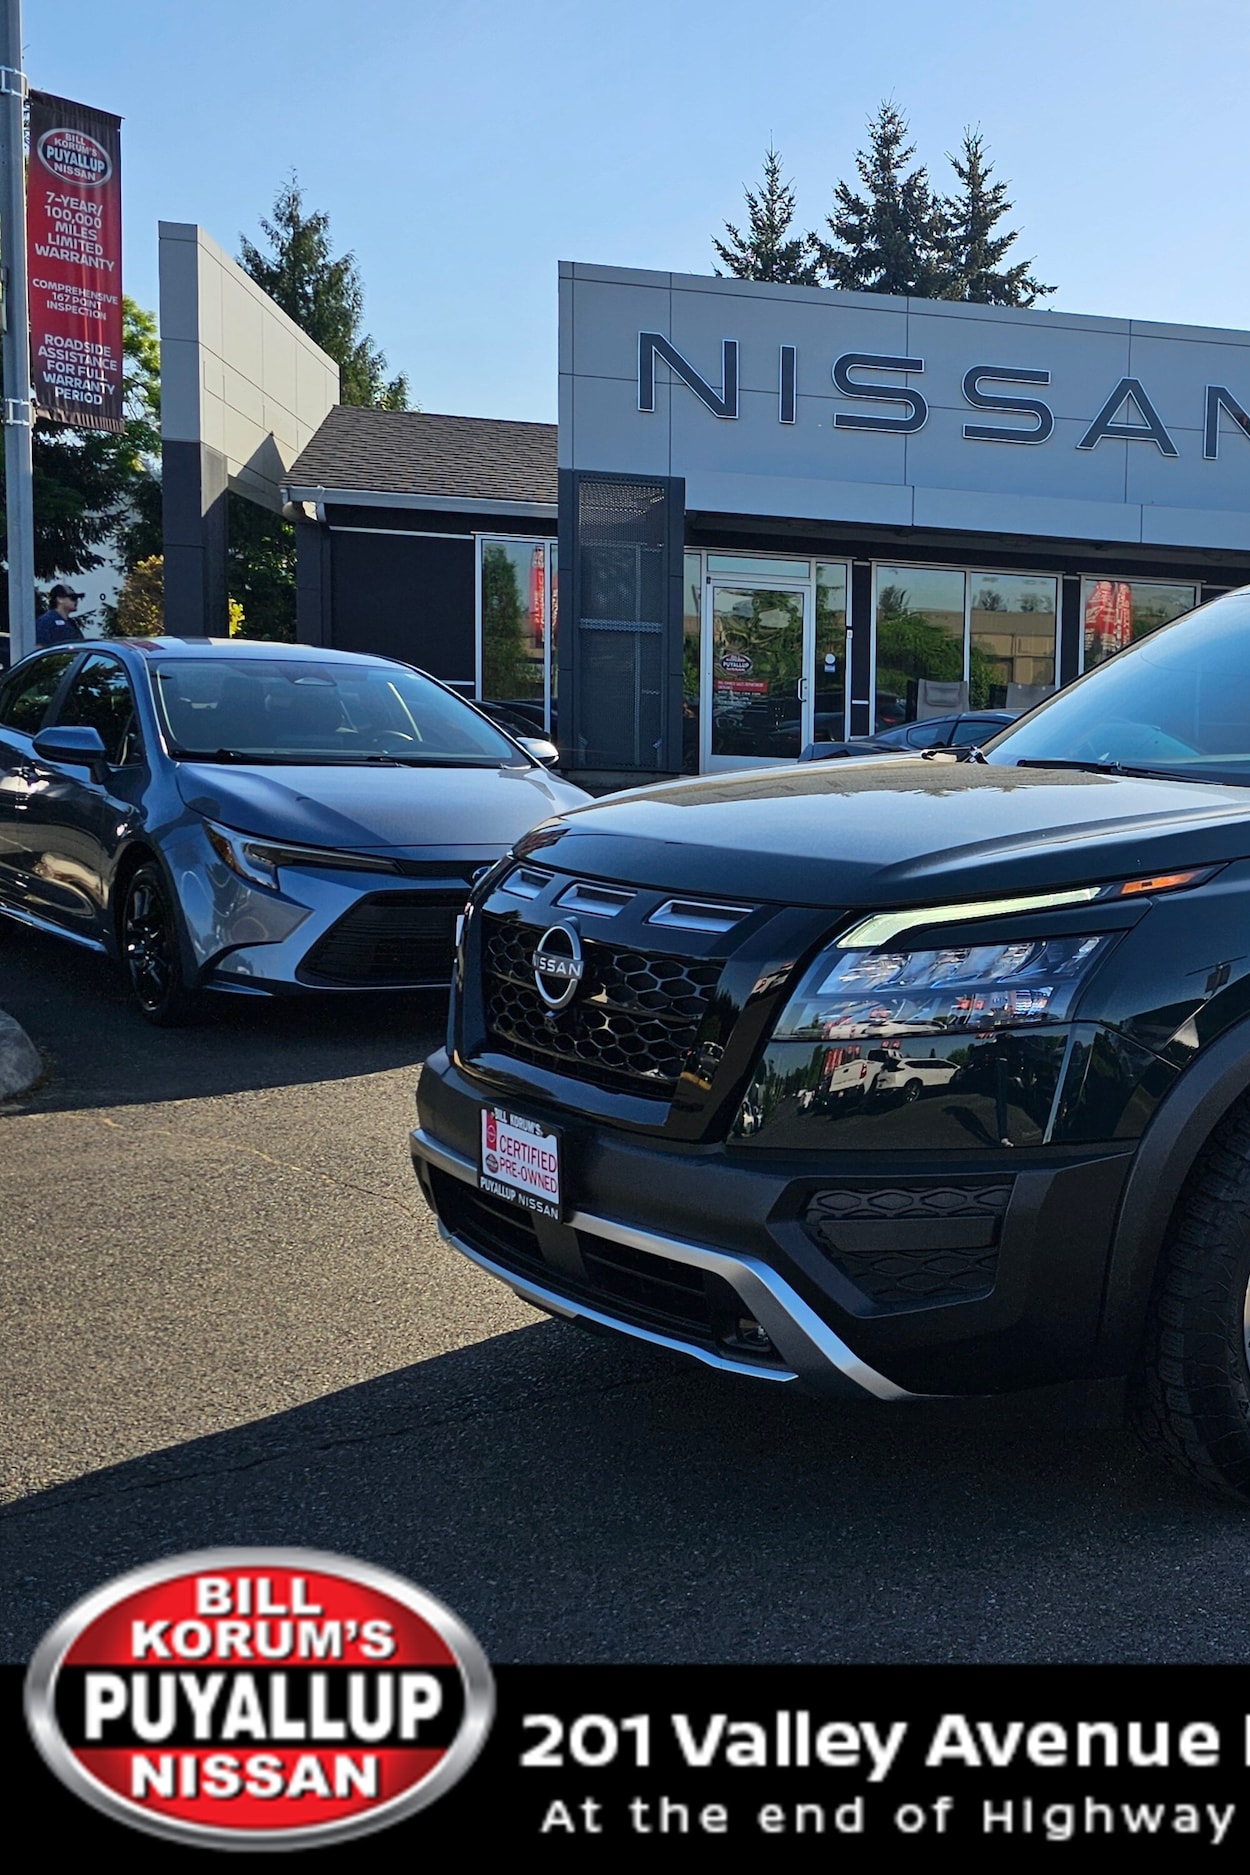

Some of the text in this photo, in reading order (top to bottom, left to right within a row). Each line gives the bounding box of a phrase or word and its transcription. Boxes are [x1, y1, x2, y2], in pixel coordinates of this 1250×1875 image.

[54, 138, 98, 157] KORUM'S
[65, 133, 86, 146] BILL
[46, 145, 105, 173] PUYALLUP
[54, 162, 96, 181] NISSAN
[46, 191, 103, 217] 7-YEAR/
[44, 205, 102, 229] 100,000
[55, 221, 98, 241] MILES
[48, 232, 104, 256] LIMITED
[34, 243, 115, 272] WARRANTY
[32, 278, 119, 305] COMPREHENSIVE
[52, 292, 102, 311] 167 POINT
[46, 300, 107, 321] INSPECTION
[44, 333, 112, 358] ROADSIDE
[38, 345, 118, 371] ASSISTANCE
[43, 371, 115, 395] WARRANTY
[46, 360, 108, 382] FOR FULL
[55, 386, 103, 405] PERIOD
[532, 953, 582, 977] NISSAN
[500, 1135, 557, 1173] CERTIFIED
[500, 1157, 558, 1194] PRE-OWNED
[480, 1176, 559, 1220] PUYALLUP NISSAN
